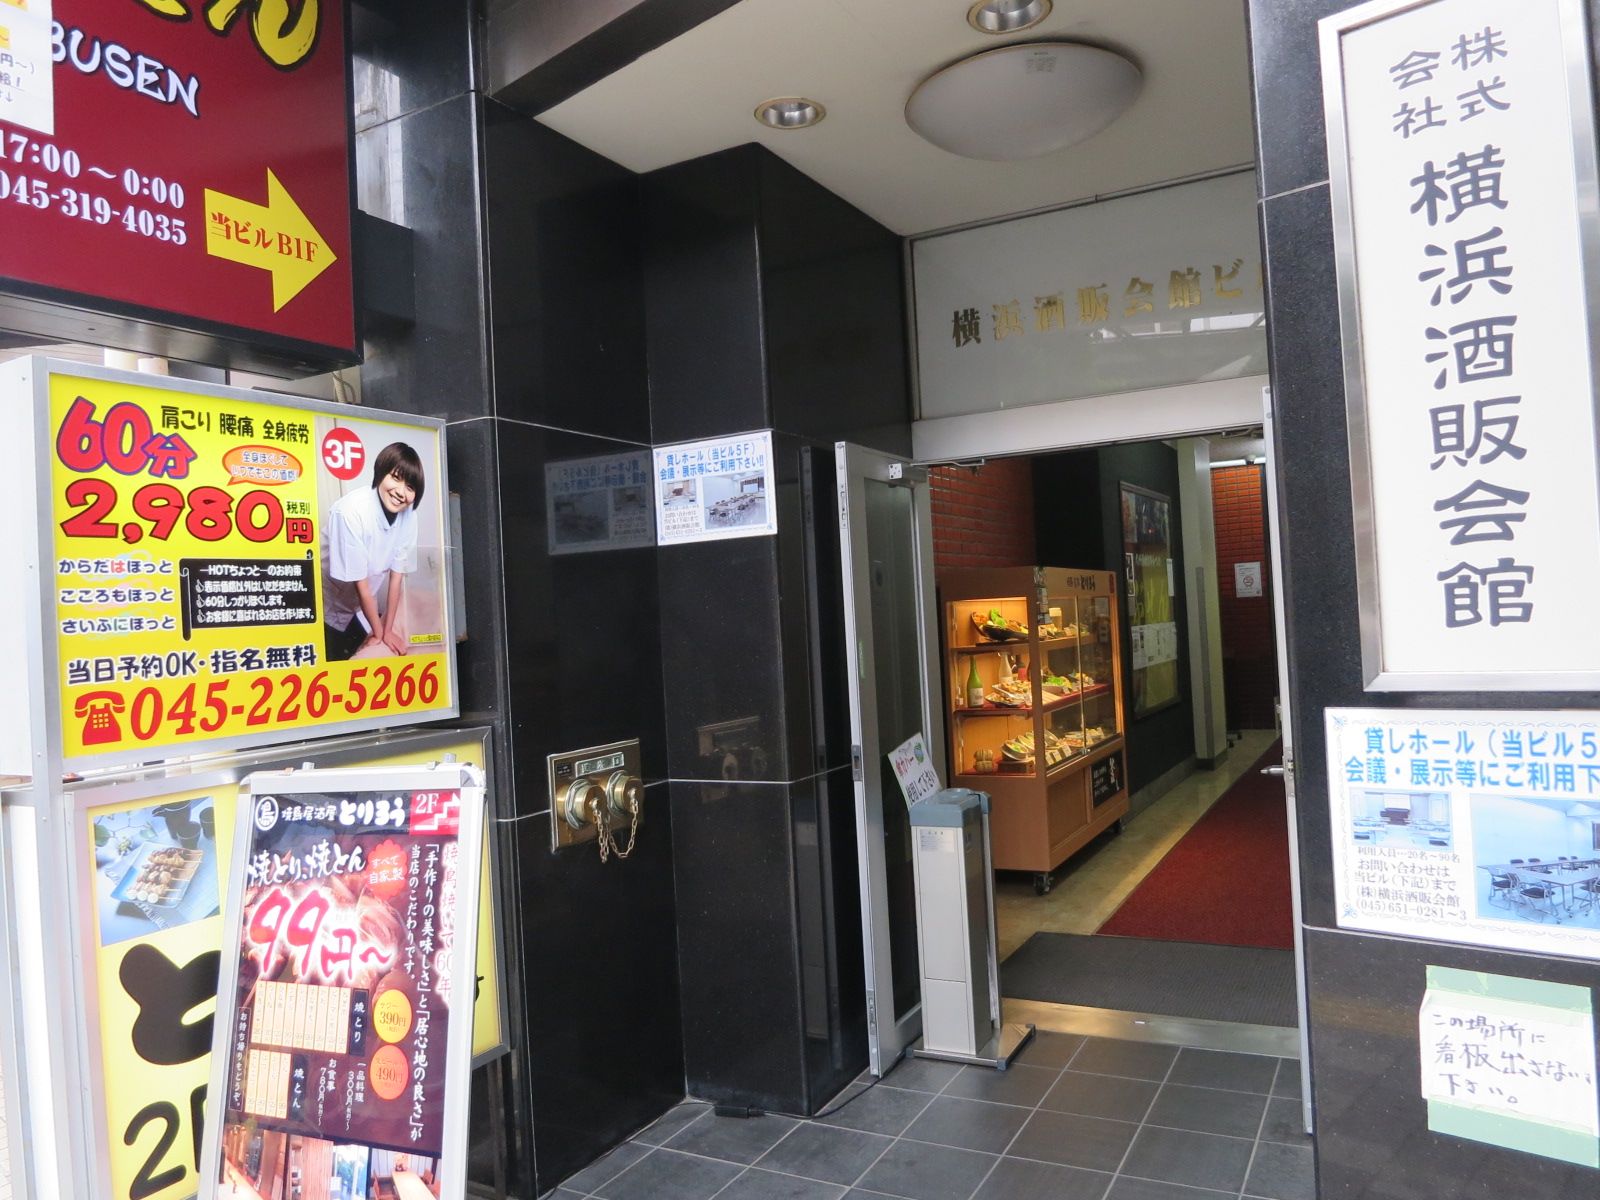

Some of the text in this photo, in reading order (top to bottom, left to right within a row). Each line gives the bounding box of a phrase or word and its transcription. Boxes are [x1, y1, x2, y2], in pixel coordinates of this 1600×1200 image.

[51, 20, 199, 117] BUSEN
[0, 169, 188, 246] 045-319-4035
[1409, 143, 1535, 629] 横浜酒販会館
[56, 395, 198, 480] 60分
[160, 405, 310, 445] 肩こり 腰痛 全身疲労
[323, 438, 362, 470] 3F
[286, 500, 311, 515] 税別
[59, 559, 173, 574] からだはほっと
[60, 587, 174, 604] こころもほっと
[61, 616, 176, 634] さいふにほっと
[129, 659, 440, 742] 045-226-5266
[415, 793, 440, 816] 2F
[367, 867, 405, 886] 自家製
[371, 855, 400, 869] すべて
[1357, 859, 1452, 878] お問い合わせは
[402, 844, 422, 980] 当店のこだわりです。
[353, 1001, 367, 1043] 焼とり
[378, 1011, 407, 1028] 390円
[1433, 1013, 1546, 1047] この場所に
[291, 1067, 305, 1110] 焼とん
[326, 1058, 338, 1092] お食事
[354, 1062, 367, 1103] 一品料理
[1438, 1073, 1519, 1105] 下さい。
